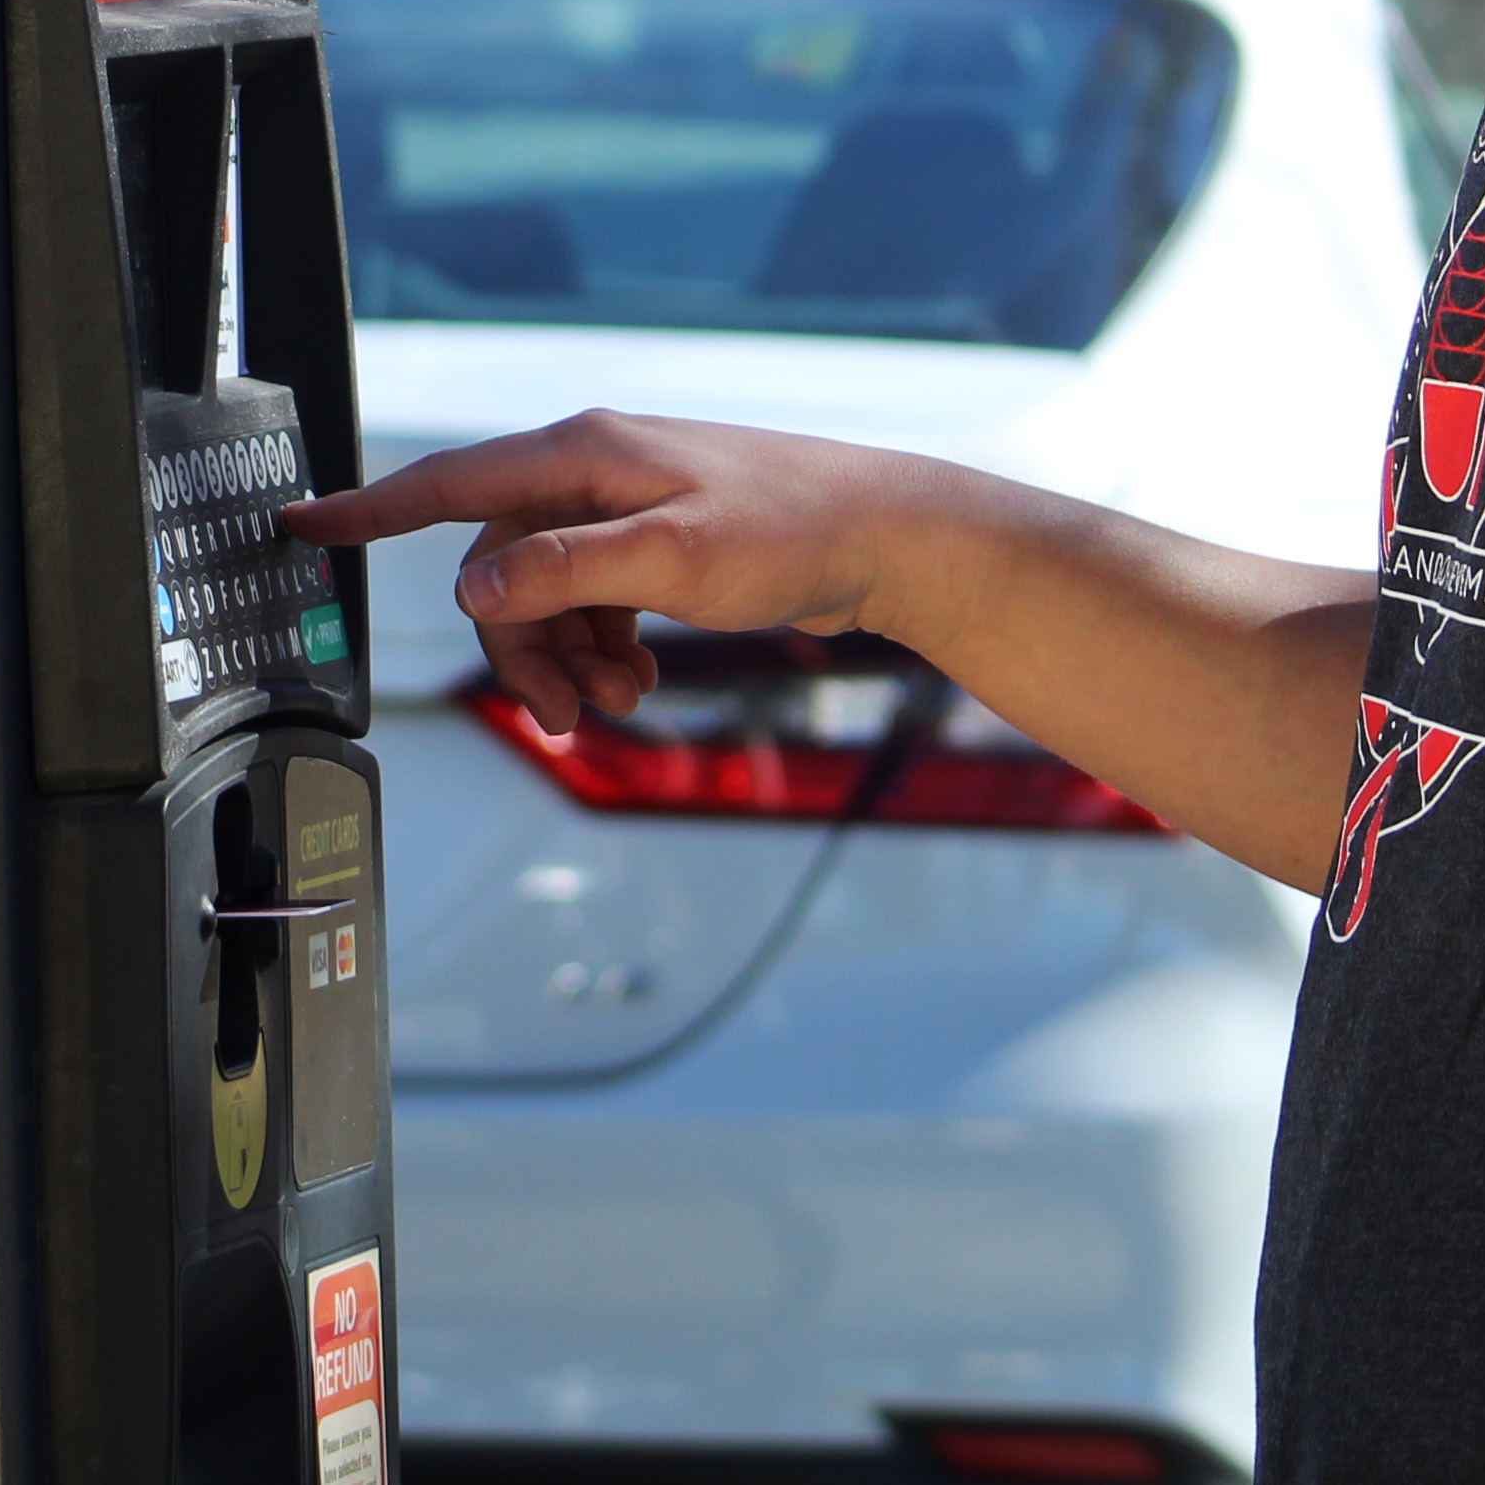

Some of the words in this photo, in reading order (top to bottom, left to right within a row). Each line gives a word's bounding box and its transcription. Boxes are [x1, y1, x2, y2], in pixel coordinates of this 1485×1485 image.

[160, 529, 175, 564] Q
[174, 527, 188, 559] W
[191, 524, 202, 555] E
[206, 522, 218, 552] R
[221, 518, 231, 548] T
[235, 515, 246, 545] Y
[250, 511, 261, 542] U
[266, 508, 275, 538] I
[174, 590, 187, 622] A
[188, 586, 200, 619] S
[203, 583, 215, 615] D
[219, 580, 228, 611] F
[234, 577, 245, 607] G
[248, 573, 260, 604] H
[265, 570, 273, 600] J
[277, 567, 289, 596] K
[293, 565, 302, 594] L
[201, 647, 214, 679] Z
[216, 644, 230, 676] X
[232, 639, 243, 671] C
[245, 636, 257, 667] V
[261, 634, 272, 664] B
[275, 631, 287, 660] N
[288, 626, 302, 658] M
[318, 619, 342, 646] PRINT
[301, 821, 330, 862] CREDIT
[331, 813, 359, 854] CARDS
[311, 947, 328, 974] VISA
[334, 1286, 357, 1335] NO
[316, 1338, 374, 1400] REFUND
